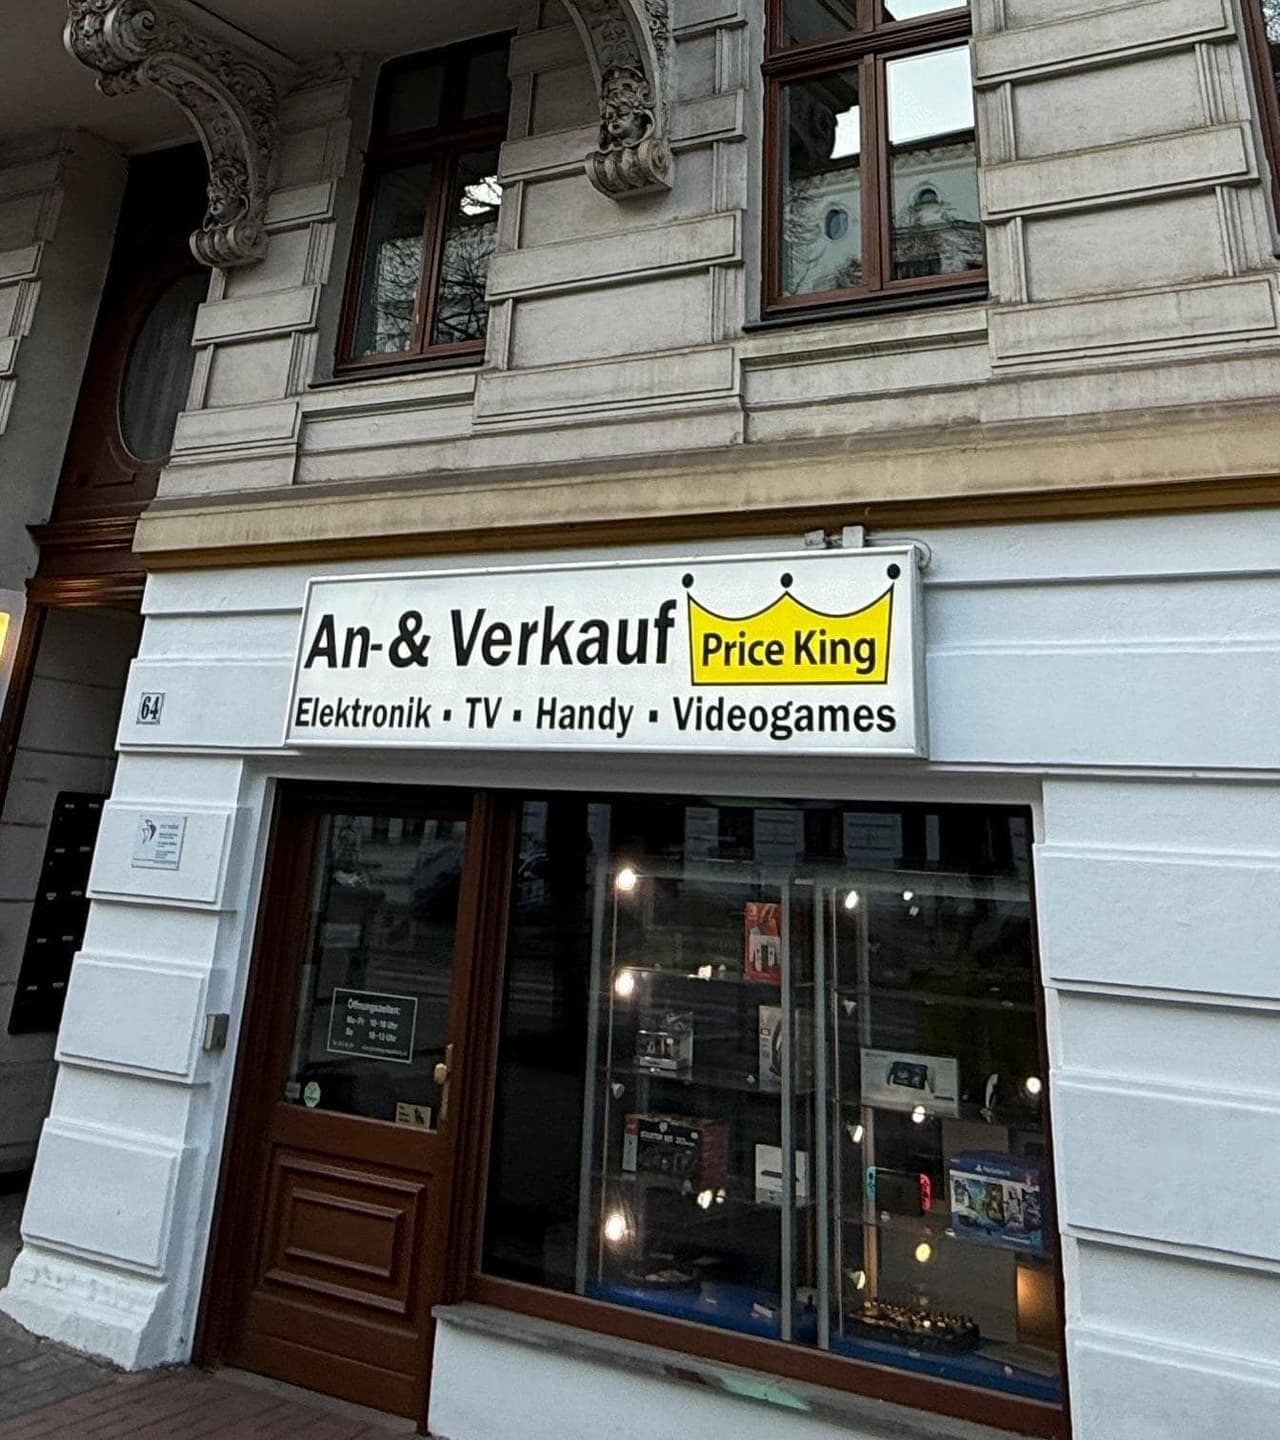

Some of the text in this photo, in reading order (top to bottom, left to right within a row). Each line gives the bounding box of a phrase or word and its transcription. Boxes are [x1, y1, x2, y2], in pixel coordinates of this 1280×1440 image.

[451, 599, 677, 667] Verkauf
[702, 631, 784, 666] Price
[794, 630, 876, 675] King
[140, 695, 161, 720] 64
[295, 697, 897, 741] Elektronik TV Handy Videogames
